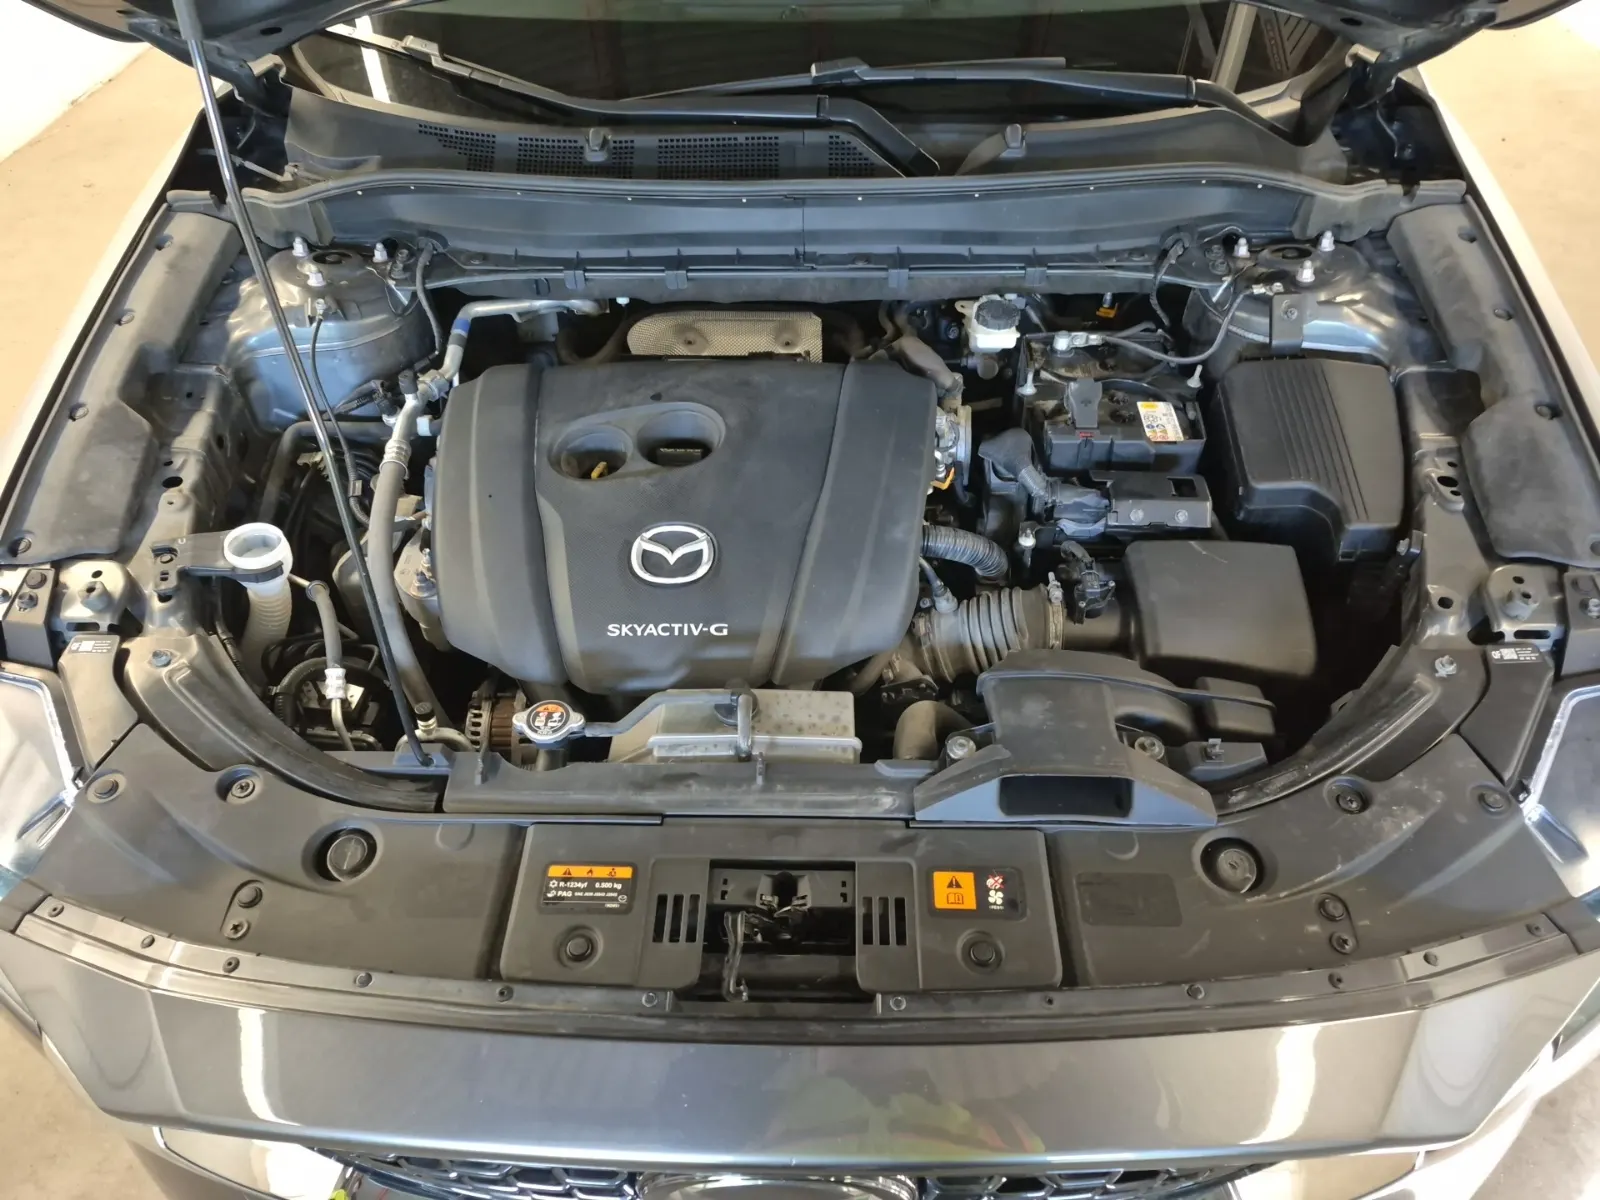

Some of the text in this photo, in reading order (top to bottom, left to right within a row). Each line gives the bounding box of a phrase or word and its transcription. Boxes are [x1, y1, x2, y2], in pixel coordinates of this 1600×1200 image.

[607, 623, 729, 636] SKYACTIV-G
[559, 881, 588, 889] R-1234yf
[613, 882, 622, 890] kg
